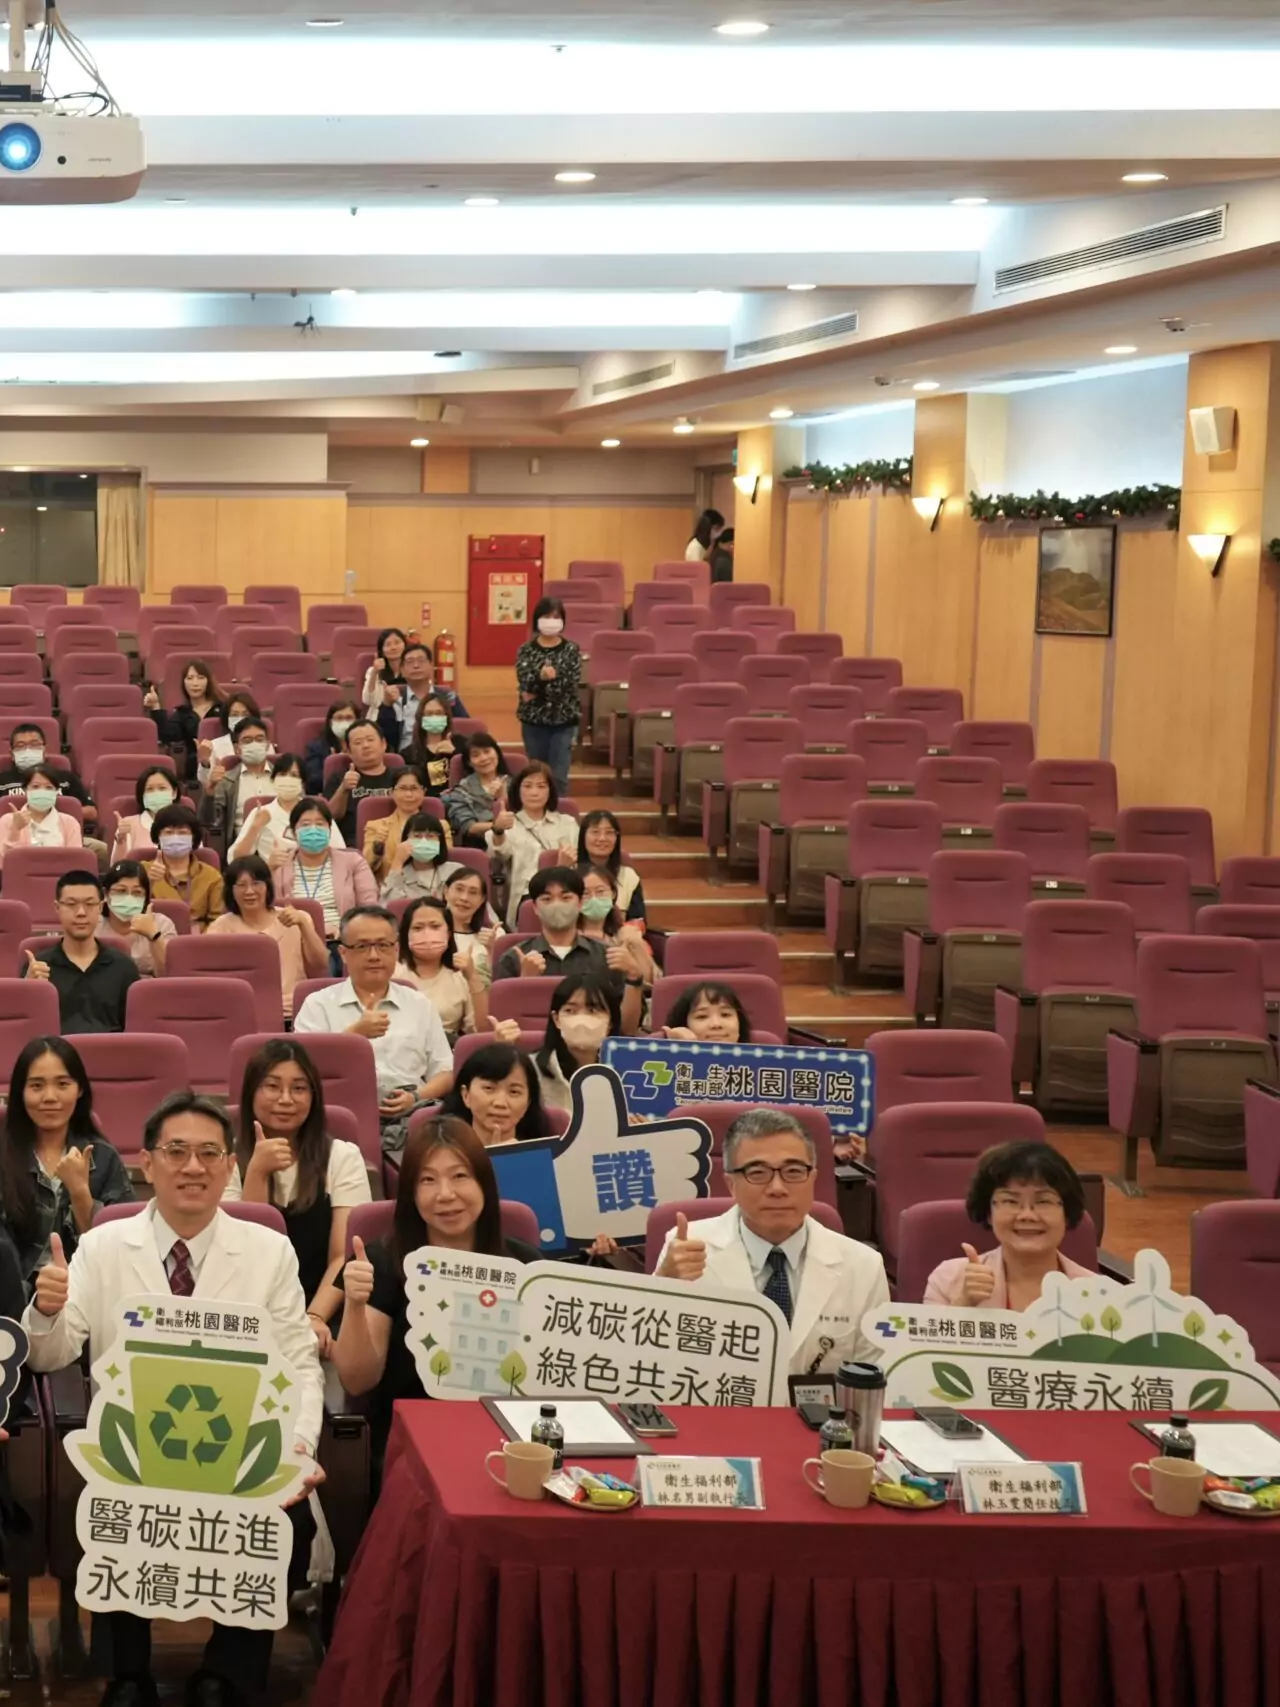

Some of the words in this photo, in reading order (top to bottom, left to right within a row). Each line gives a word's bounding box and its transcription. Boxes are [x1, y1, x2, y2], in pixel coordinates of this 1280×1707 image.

[675, 1063, 725, 1081] 衛生
[725, 1066, 854, 1101] 桃園醫院
[675, 1080, 725, 1096] 福利部
[592, 1149, 659, 1213] 讚
[461, 1265, 517, 1285] 桃園醫院
[185, 1311, 260, 1334] 桃園醫院
[542, 1294, 761, 1362] 減碳從醫起
[939, 1318, 1017, 1340] 桃園醫院
[536, 1346, 758, 1407] 綠色共永續
[988, 1366, 1174, 1410] 醫療永續
[664, 1474, 738, 1488] 衛生福利部
[988, 1480, 1063, 1493] 衛生福利部
[88, 1497, 279, 1560] 醫碳並進
[86, 1555, 277, 1618] 永續共榮
